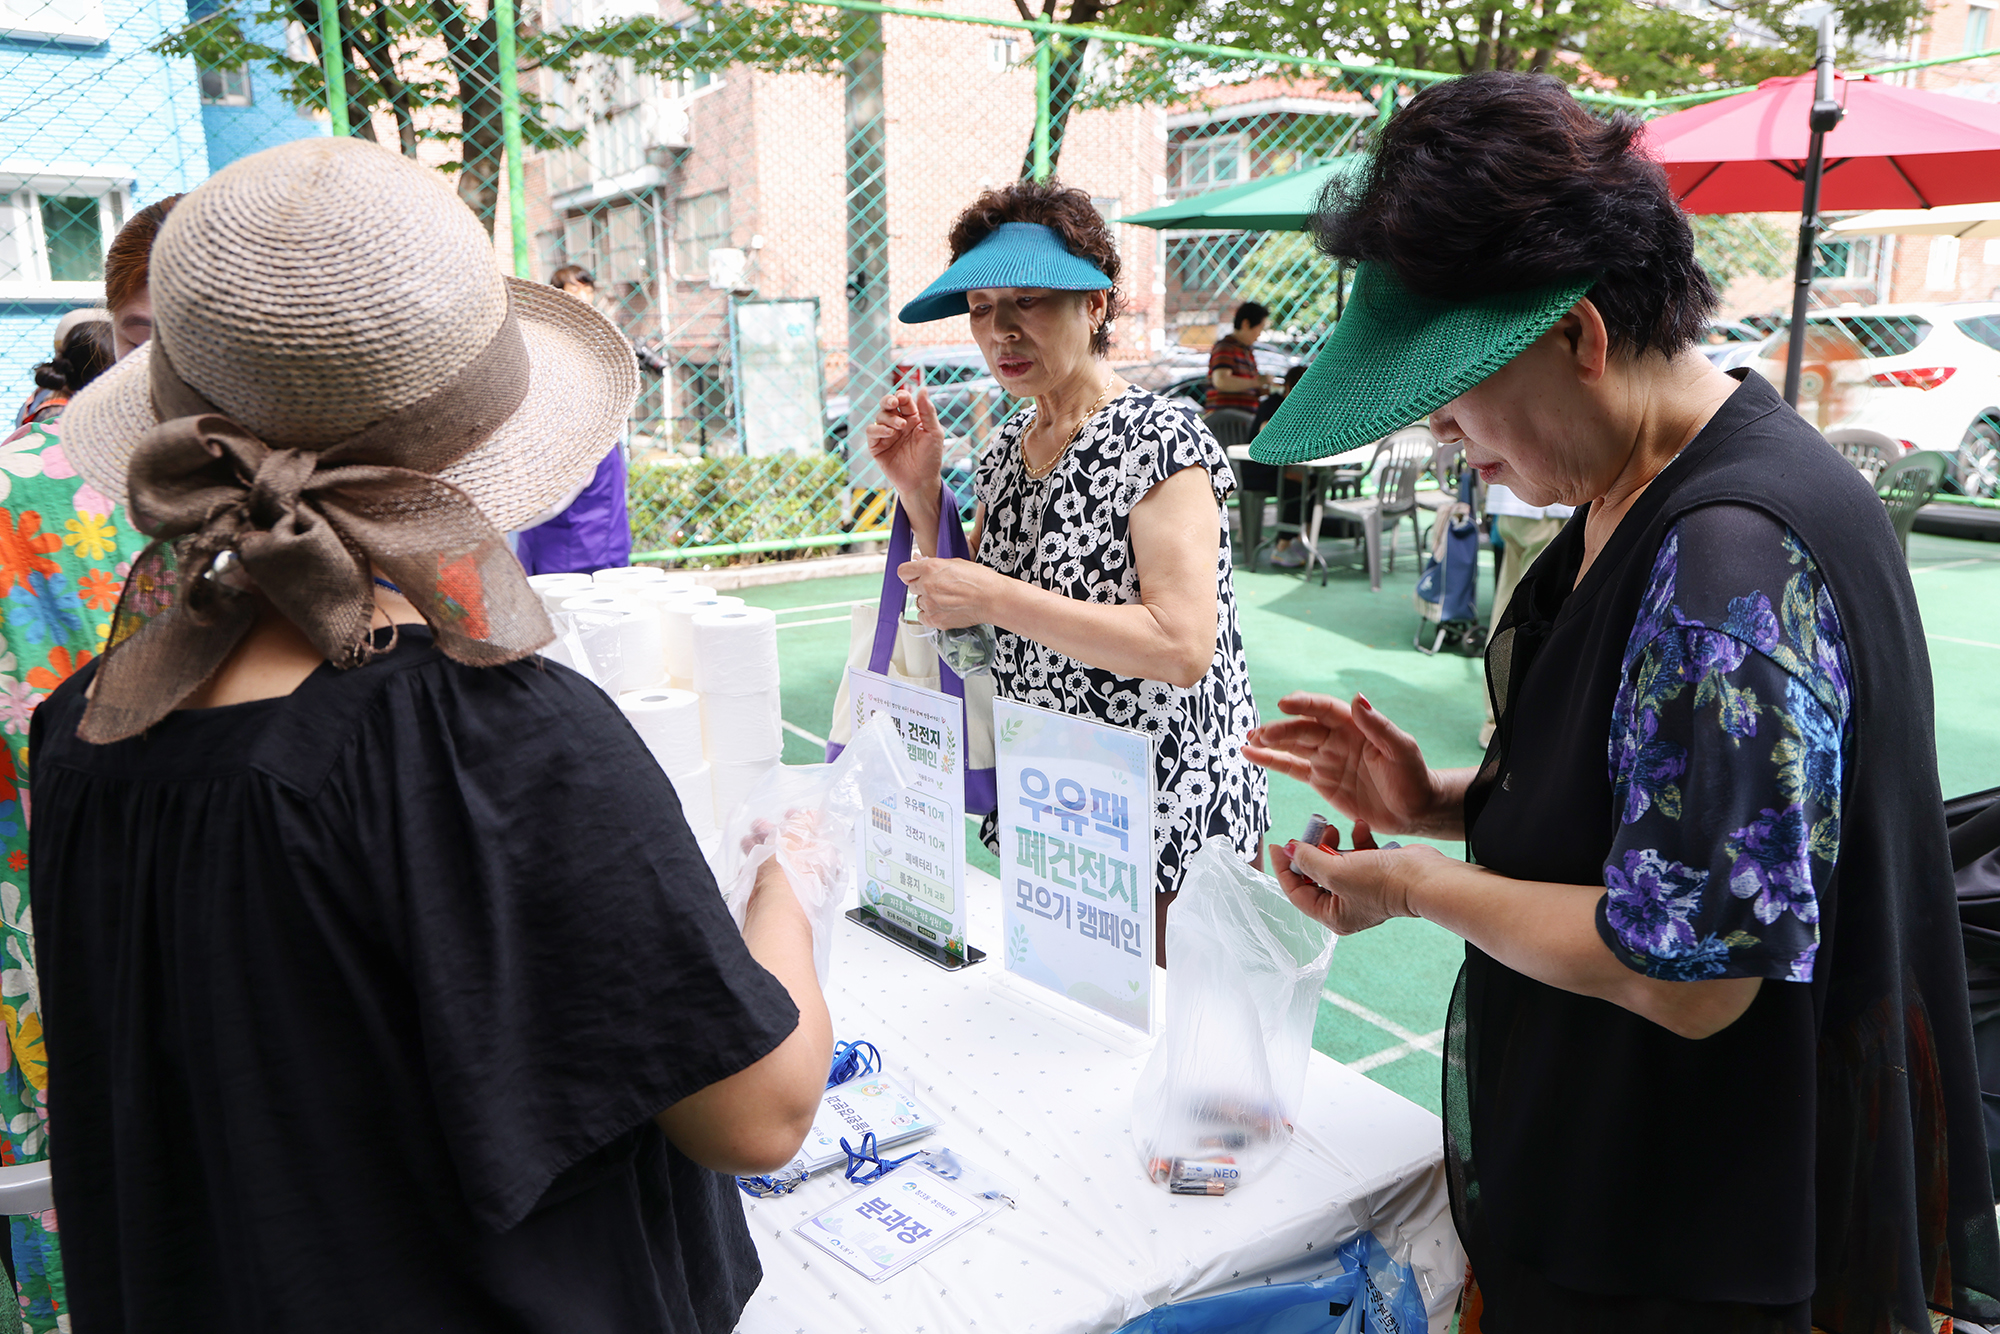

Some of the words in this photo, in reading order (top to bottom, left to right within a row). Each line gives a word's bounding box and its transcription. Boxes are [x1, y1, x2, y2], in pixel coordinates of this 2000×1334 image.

[908, 722, 941, 750] 건전지
[906, 743, 937, 769] 캠페인
[904, 796, 926, 814] 우유팩
[927, 805, 944, 822] 10개
[1018, 767, 1129, 852] 우유팩
[905, 824, 926, 844] 건전지
[928, 834, 946, 852] 10개
[935, 865, 946, 880] 1개
[1015, 826, 1138, 913] 폐건전지
[900, 872, 920, 892] 롤휴지
[923, 883, 934, 898] 1개
[934, 889, 946, 902] 교환
[1016, 878, 1072, 930] 모으기
[1077, 901, 1142, 958] 캠페인
[1214, 1168, 1238, 1179] NEO
[856, 1196, 933, 1244] 분과장
